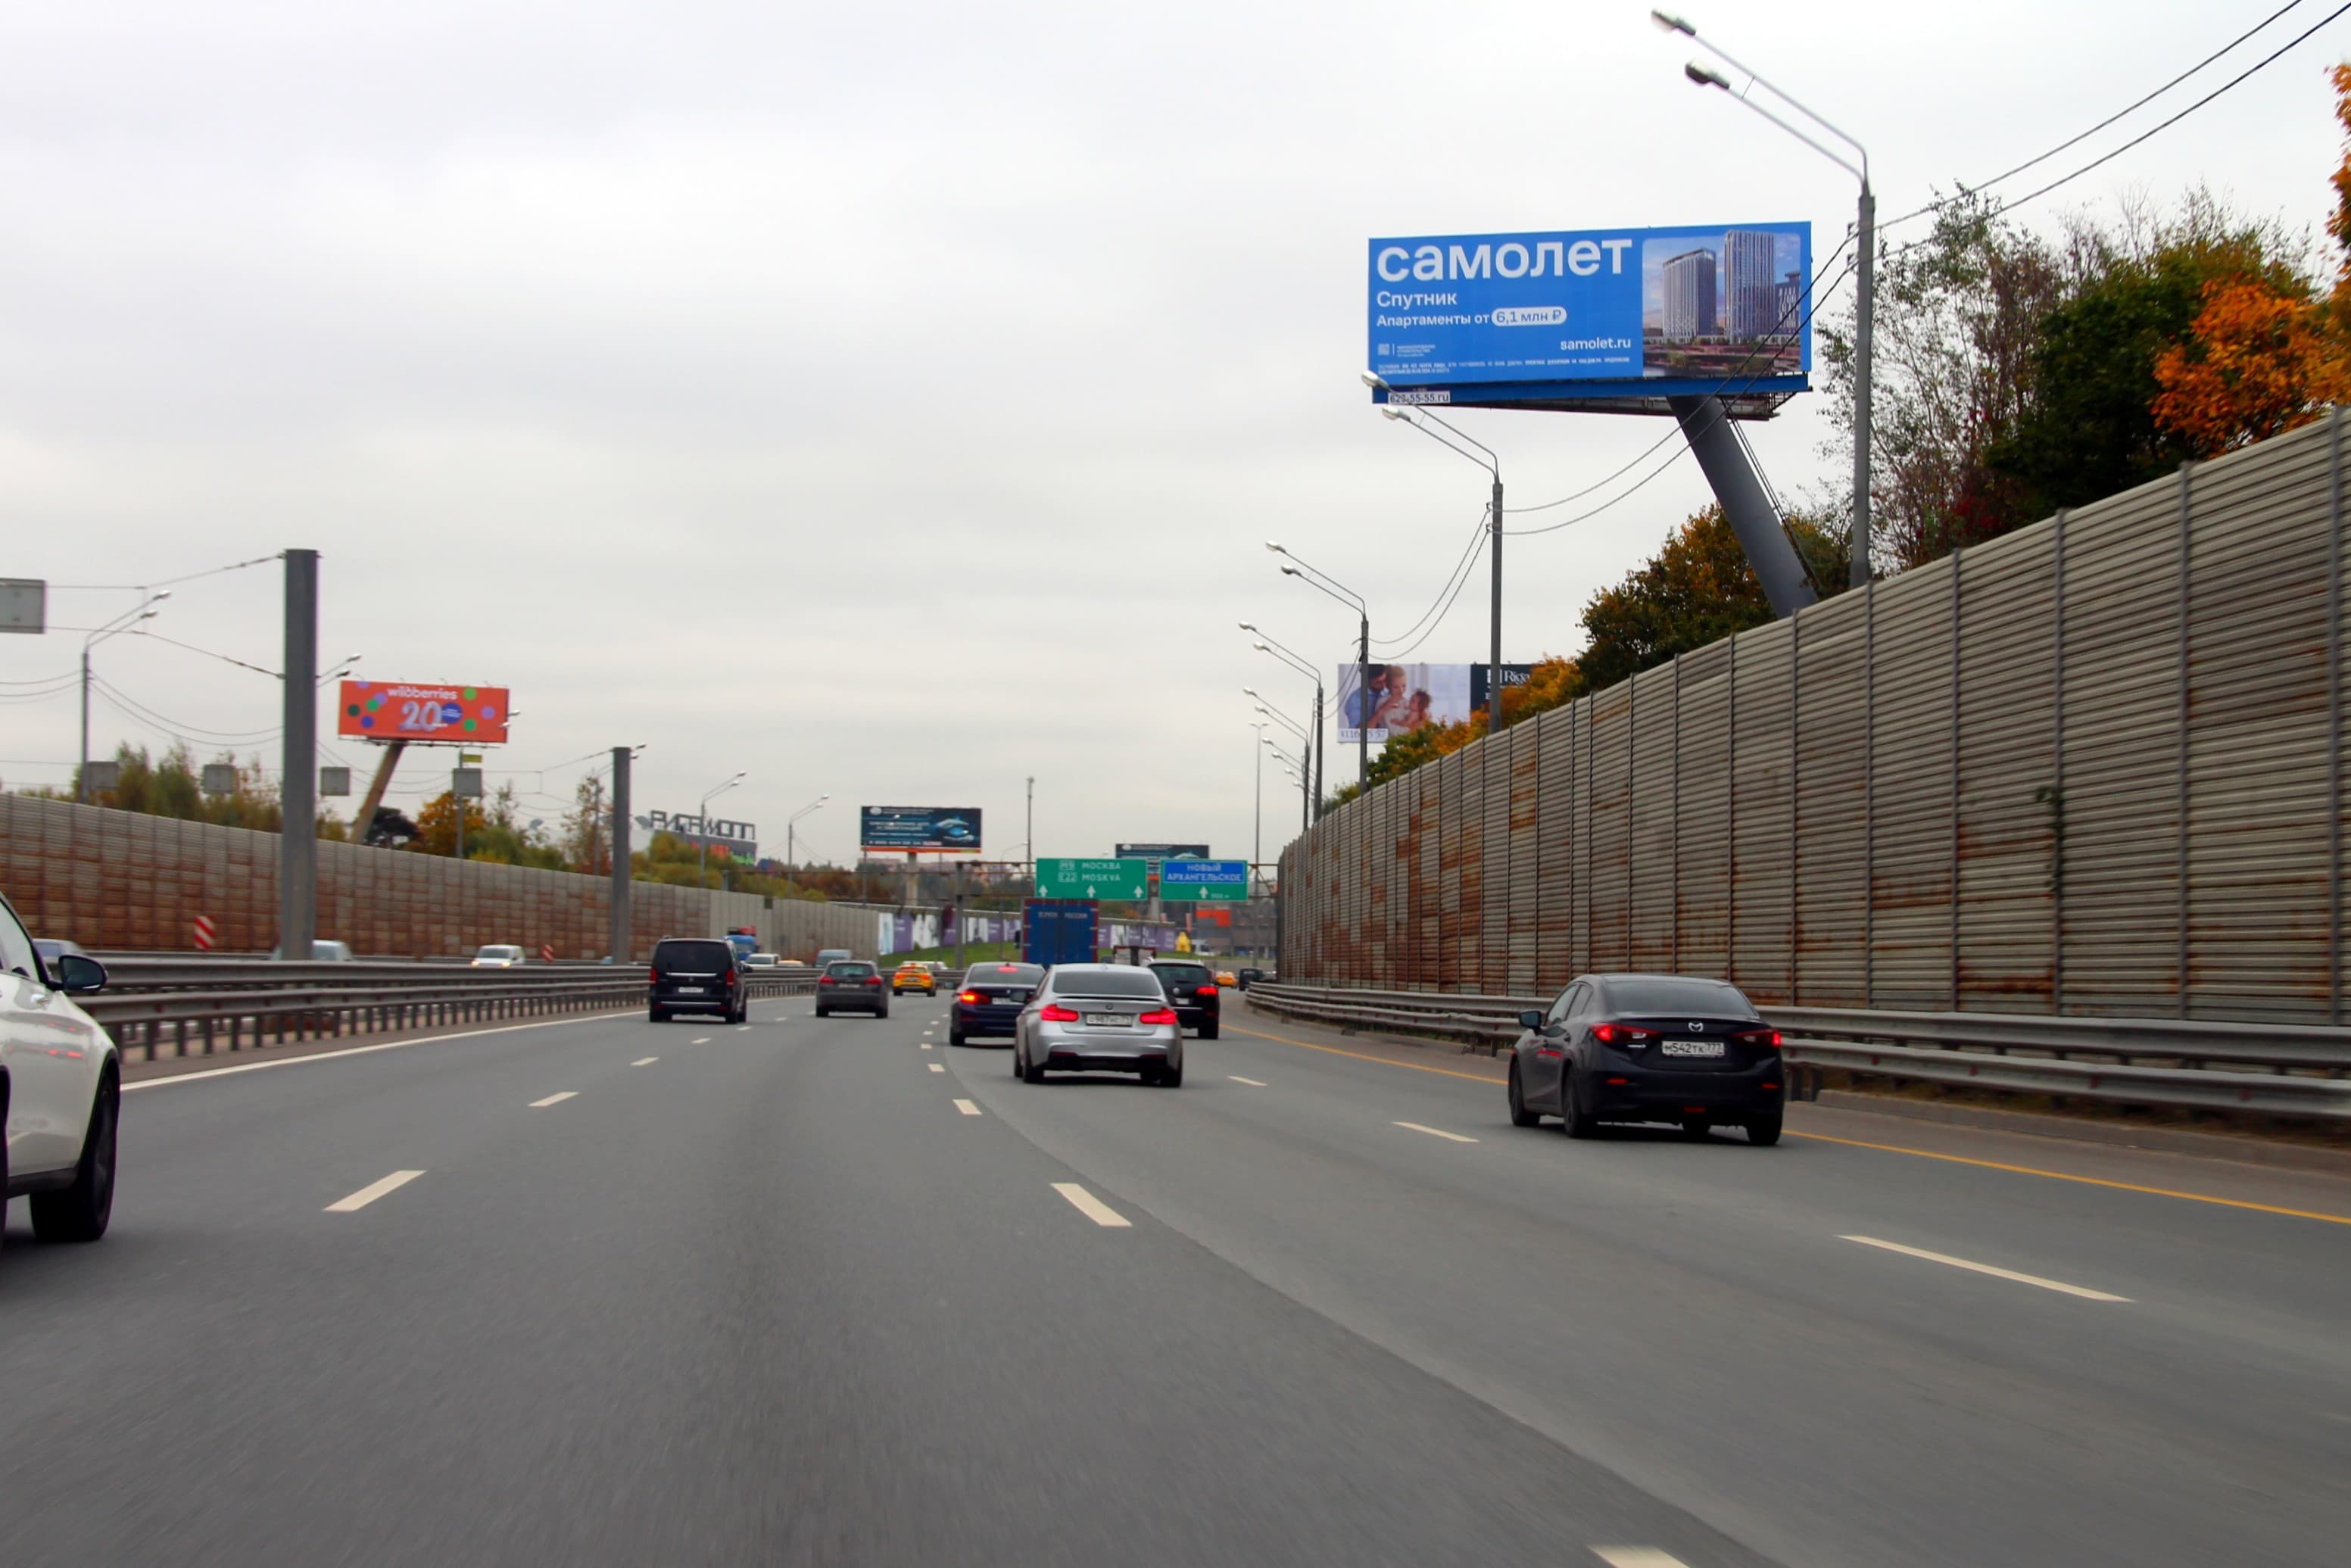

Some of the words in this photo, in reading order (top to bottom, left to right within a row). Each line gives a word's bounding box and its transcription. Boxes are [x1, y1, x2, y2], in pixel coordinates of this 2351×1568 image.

[1377, 238, 1632, 282] самолет
[1377, 291, 1458, 310] Спутник
[1377, 314, 1471, 329] Апартаменты
[1474, 315, 1489, 325] от
[1496, 310, 1517, 325] 6,1
[1520, 312, 1548, 323] млн
[1560, 337, 1632, 351] samolet.ru
[387, 684, 458, 700] wildberries
[1081, 862, 1121, 870] МОСКВА
[1186, 862, 1222, 872] НОВЫЙ
[1081, 873, 1121, 882] MOSKVA
[1166, 872, 1243, 882] АРХАНГЕЛЬСКОЕ
